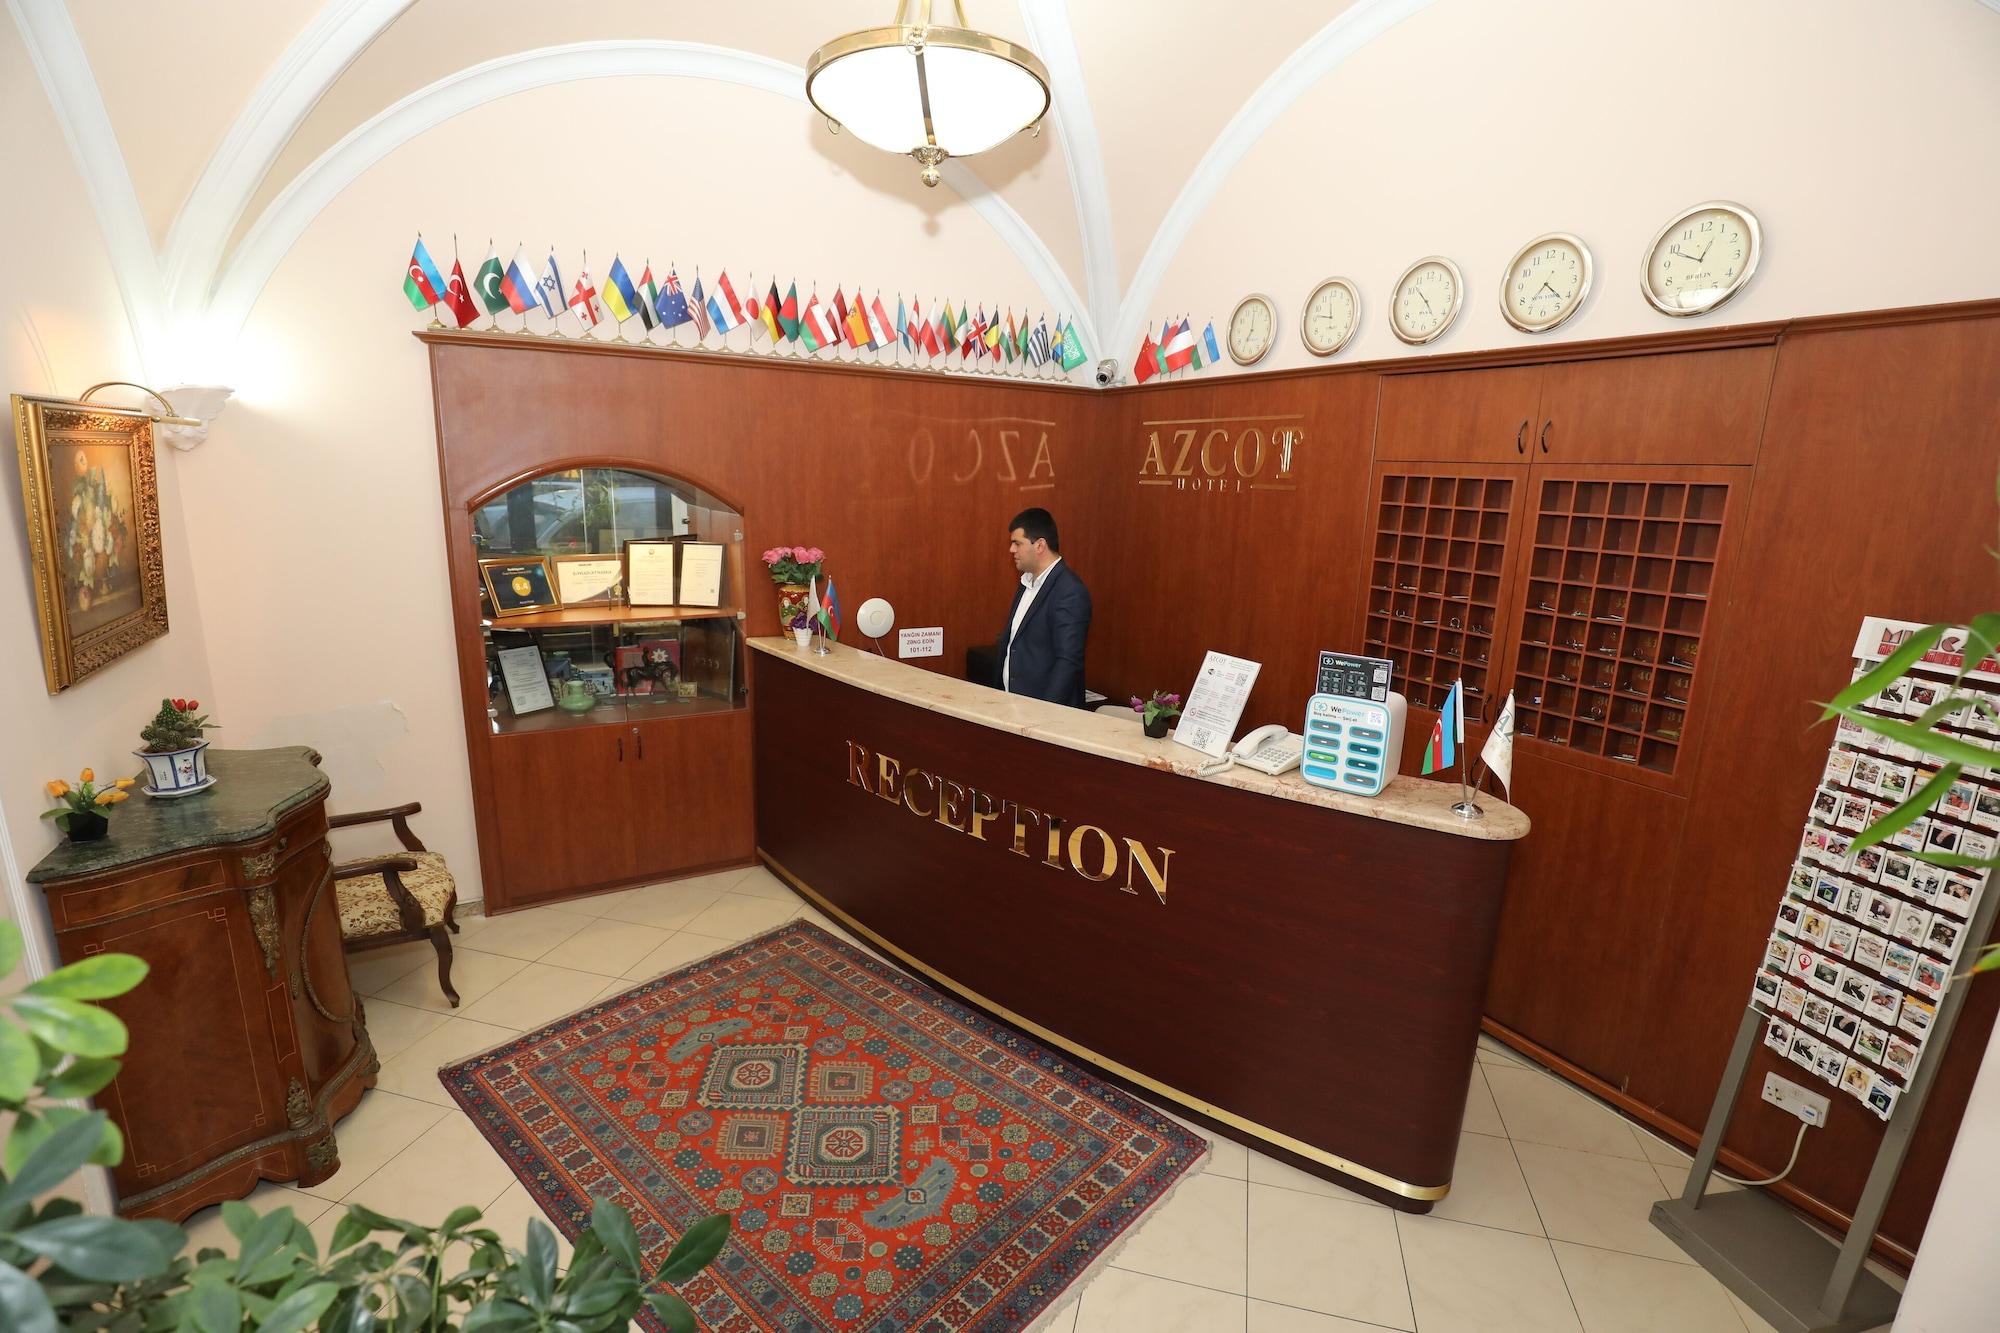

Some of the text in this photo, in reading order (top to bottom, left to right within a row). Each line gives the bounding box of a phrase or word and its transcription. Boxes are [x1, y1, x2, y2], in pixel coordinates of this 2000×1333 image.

[1700, 222, 1712, 232] 12
[1720, 224, 1725, 233] 1
[1684, 230, 1692, 240] 11
[1730, 233, 1738, 243] 2
[1670, 244, 1680, 254] 10
[1546, 250, 1556, 259] 12
[1562, 252, 1565, 260] 1
[1732, 249, 1740, 259] 3
[1534, 257, 1540, 266] 11
[1569, 260, 1575, 269] 2
[1663, 261, 1671, 270] 9
[1523, 268, 1531, 277] 10
[1686, 272, 1711, 280] BERLIN
[1725, 267, 1733, 277] 4
[1571, 275, 1577, 284] 3
[1665, 277, 1673, 286] 8
[1139, 427, 1304, 478] AZCOT
[1177, 478, 1243, 494] HOTEL
[1335, 660, 1361, 668] WePower
[1330, 706, 1364, 717] WePower
[846, 739, 1176, 905] RECEPTION
